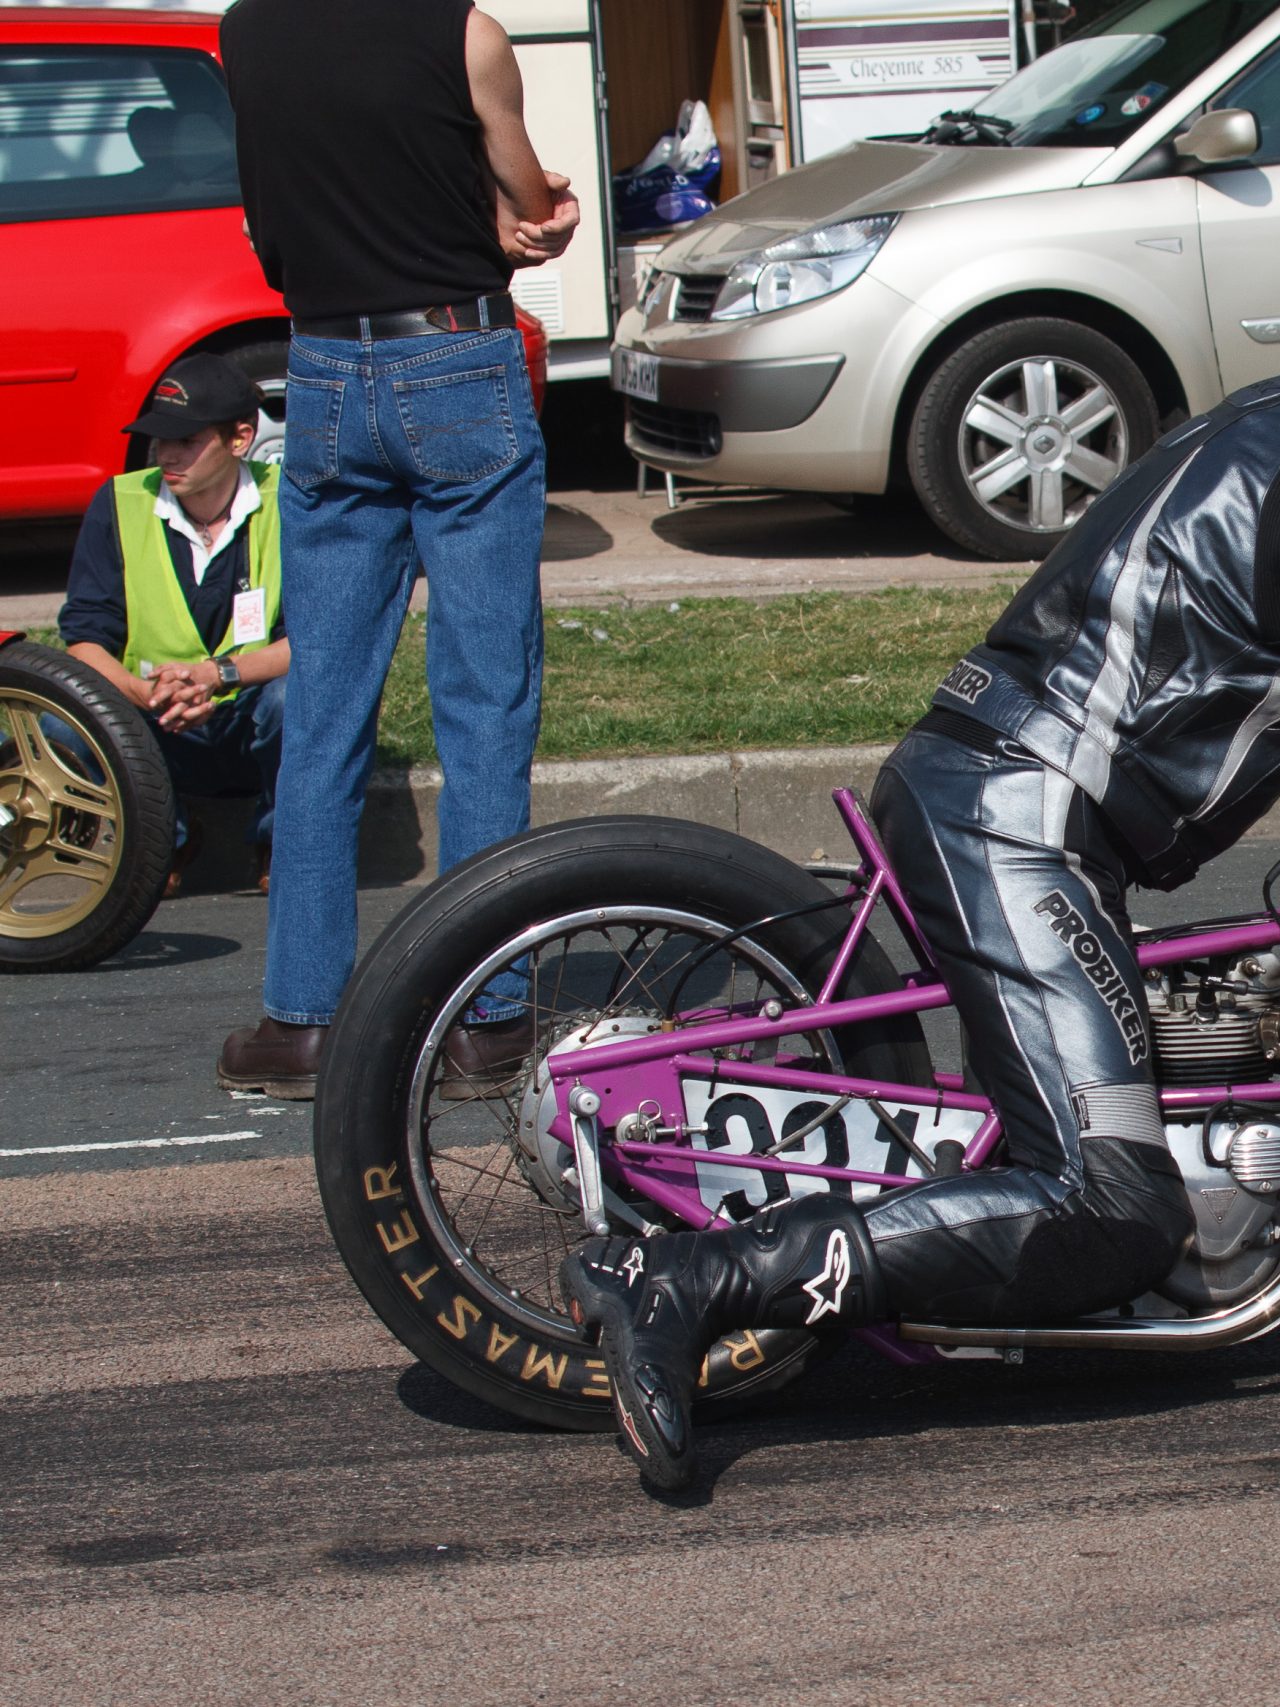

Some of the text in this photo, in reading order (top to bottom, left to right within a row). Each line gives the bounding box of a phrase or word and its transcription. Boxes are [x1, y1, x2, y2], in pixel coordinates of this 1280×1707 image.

[850, 56, 963, 83] Cheyenne 585
[1032, 888, 1148, 1066] PROBIKER
[363, 1160, 766, 1398] REMASTER
